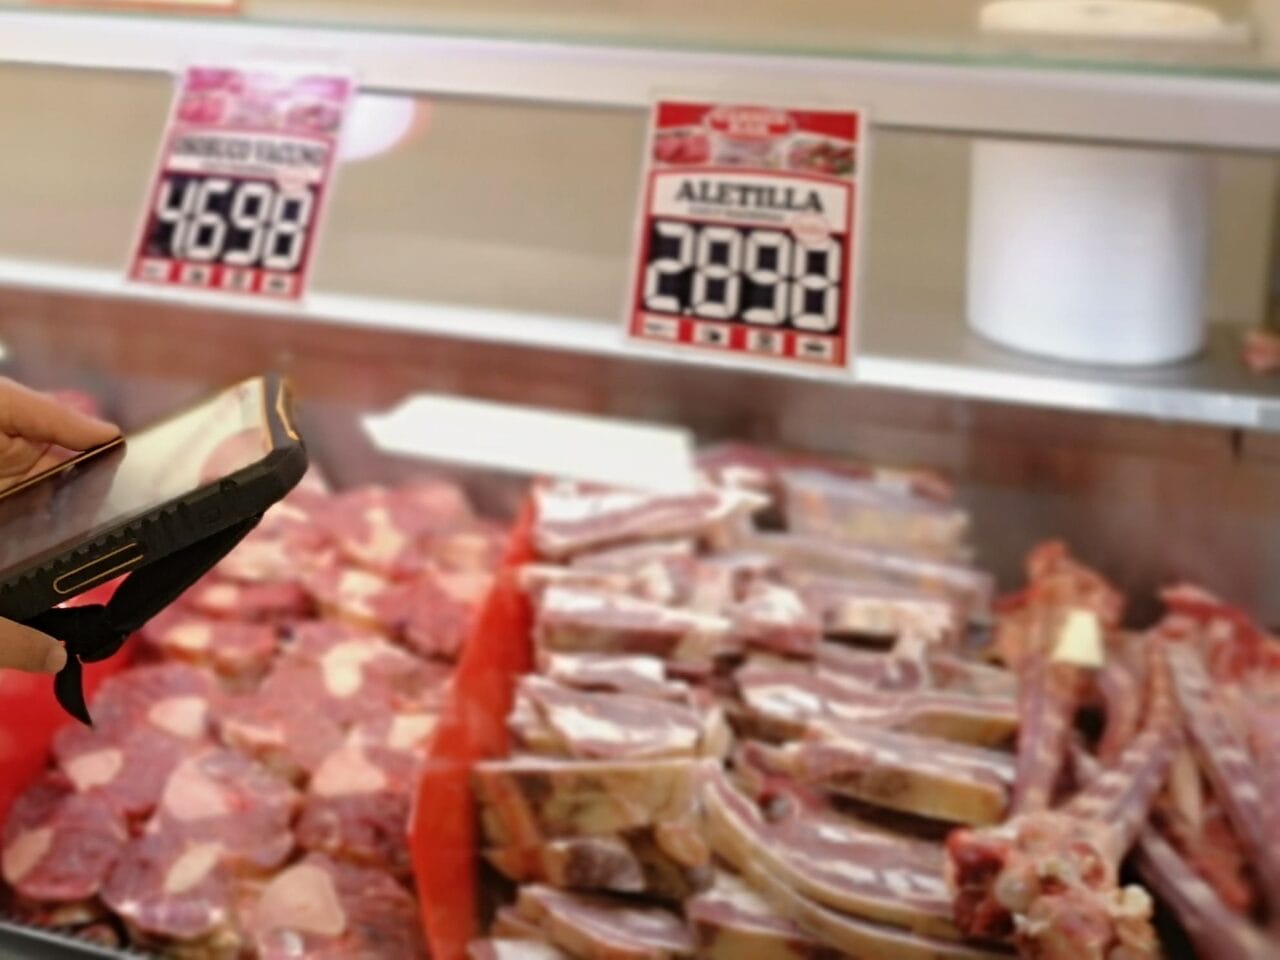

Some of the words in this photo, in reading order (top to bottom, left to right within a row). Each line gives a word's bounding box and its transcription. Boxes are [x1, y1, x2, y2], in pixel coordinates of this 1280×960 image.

[155, 178, 314, 270] 4698
[675, 179, 825, 213] ALETILLA
[642, 220, 842, 333] 2898
